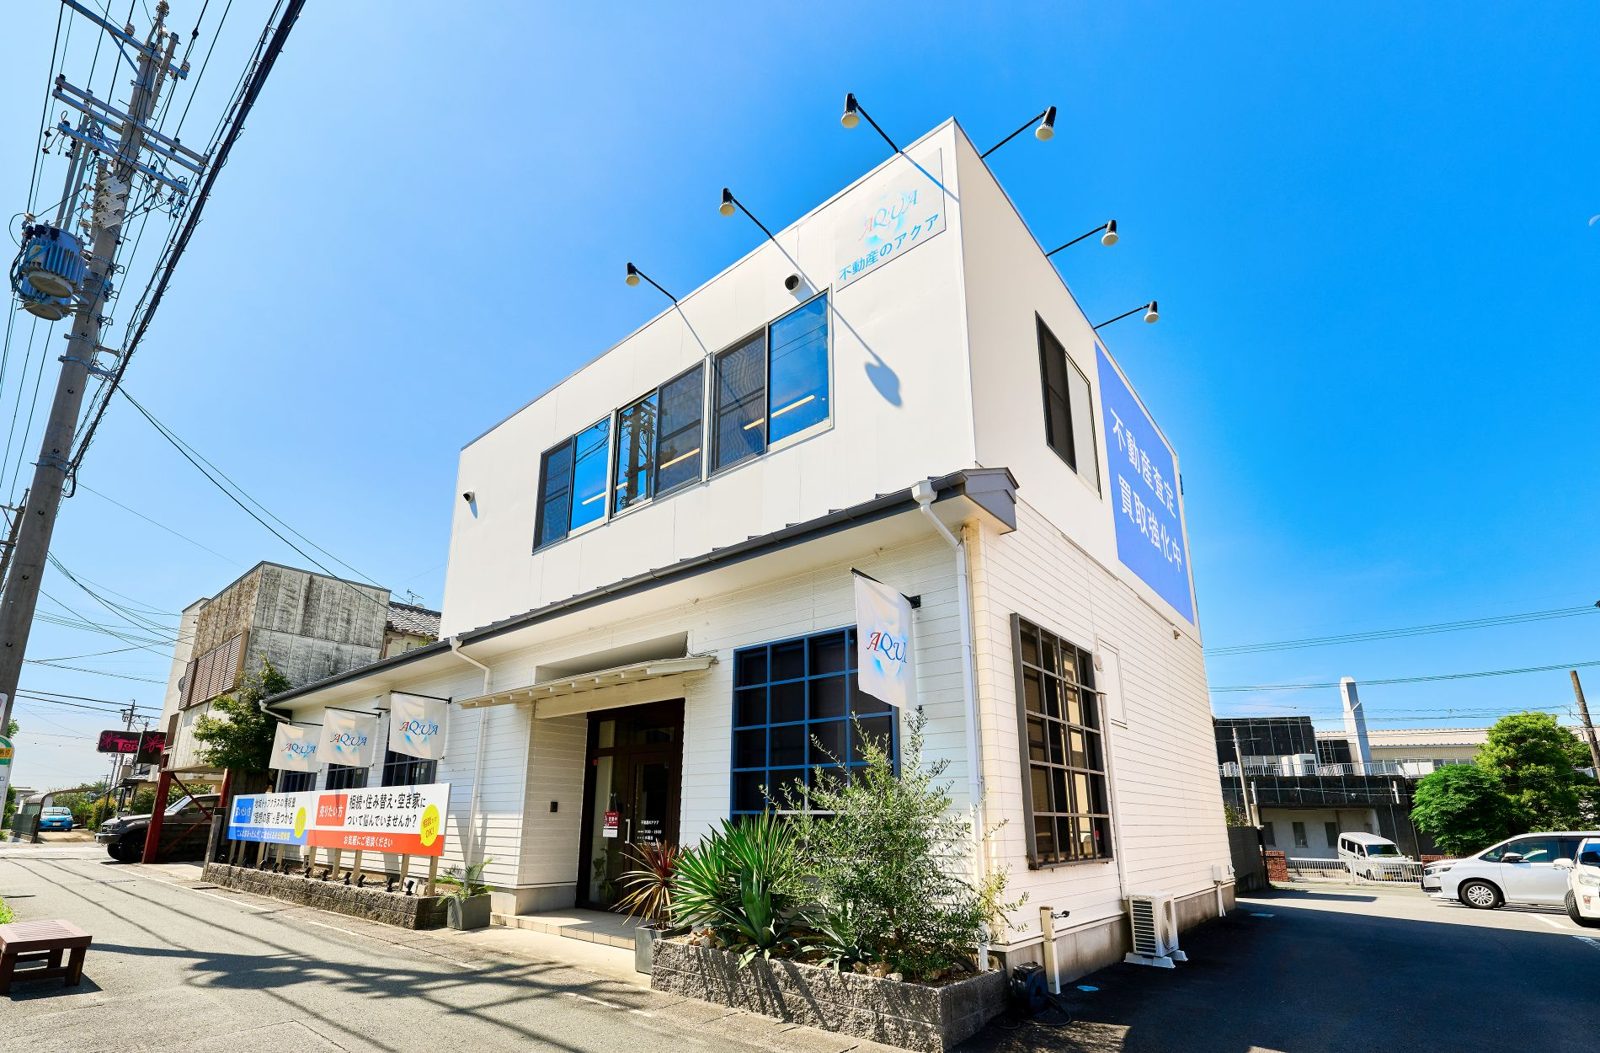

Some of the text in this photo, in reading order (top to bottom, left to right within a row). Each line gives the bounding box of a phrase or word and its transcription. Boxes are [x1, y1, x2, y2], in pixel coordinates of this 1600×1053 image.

[858, 189, 919, 241] AQUA
[838, 213, 940, 281] 不動産のアクア
[1110, 407, 1177, 519] 不動産査定
[1117, 473, 1183, 573] 買取強化中
[399, 719, 440, 736] AQUA
[280, 742, 317, 755] AQUA
[329, 732, 368, 747] AQUA
[348, 792, 427, 811] 相続・住み替え・空き家に
[343, 835, 393, 848] お気軽にご相談ください
